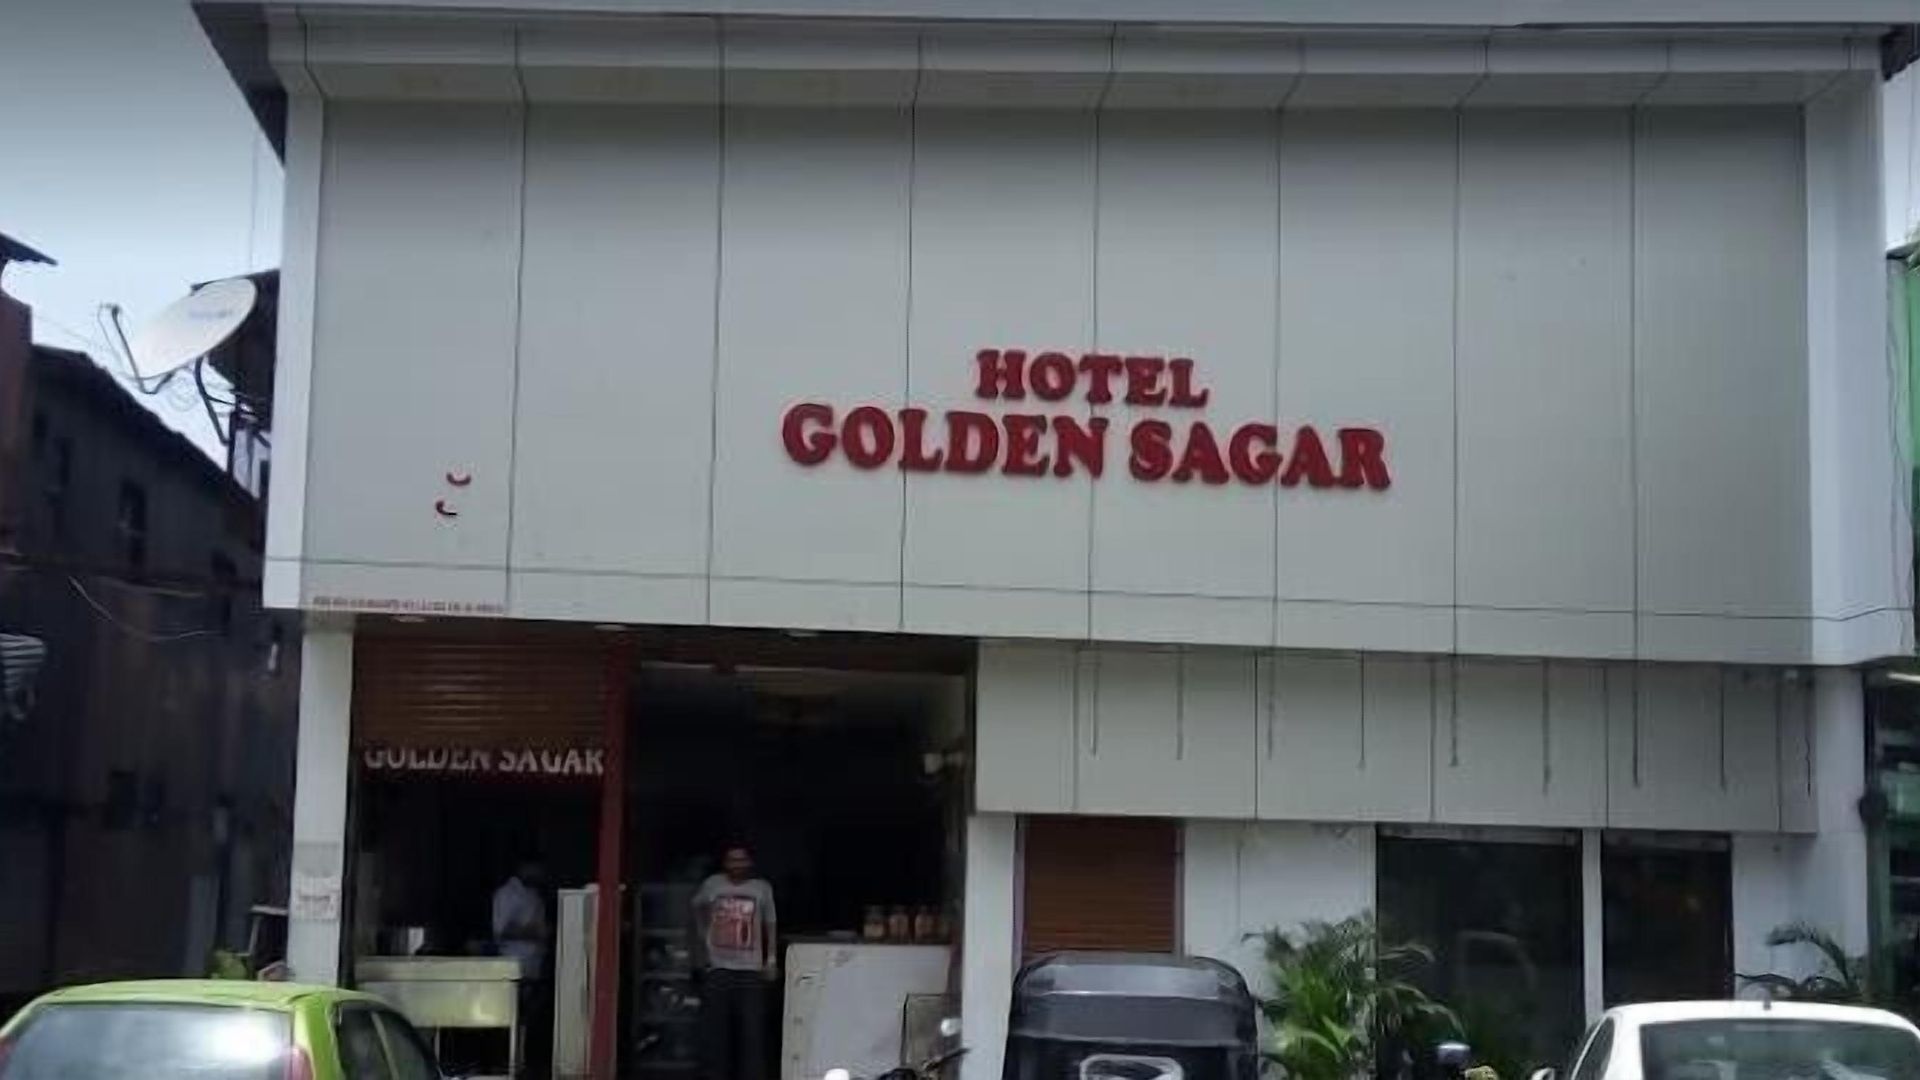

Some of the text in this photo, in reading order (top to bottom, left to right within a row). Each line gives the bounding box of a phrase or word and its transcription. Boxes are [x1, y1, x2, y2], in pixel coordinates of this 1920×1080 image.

[976, 349, 1209, 408] HOTEL
[782, 403, 1390, 490] GOLDEN SAGAR
